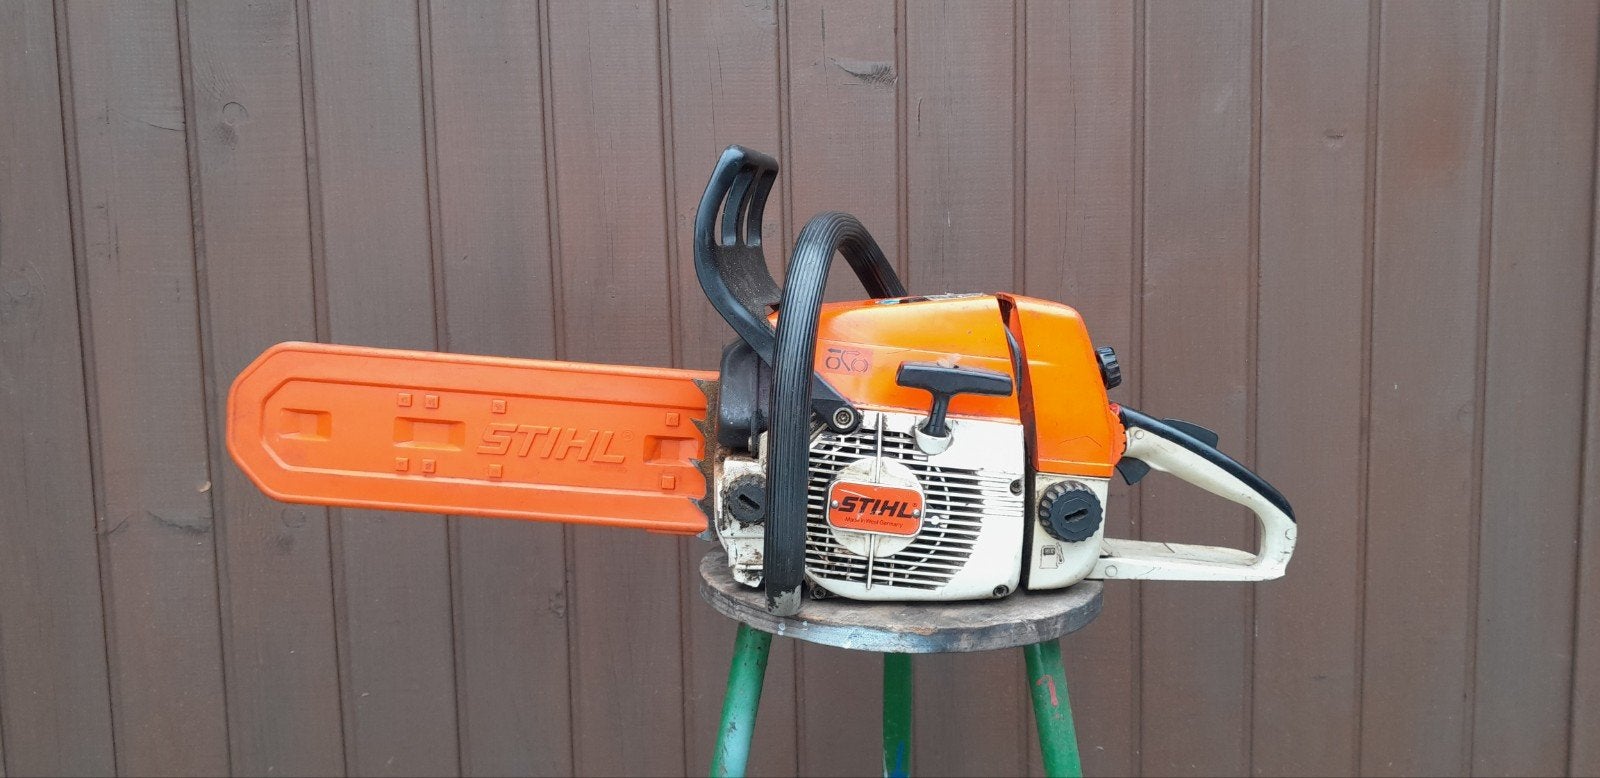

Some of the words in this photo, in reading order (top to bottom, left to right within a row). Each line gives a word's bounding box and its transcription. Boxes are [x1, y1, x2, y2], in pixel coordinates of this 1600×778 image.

[477, 422, 626, 464] STIHL
[838, 496, 914, 519] STIHL
[879, 519, 904, 528] Germany
